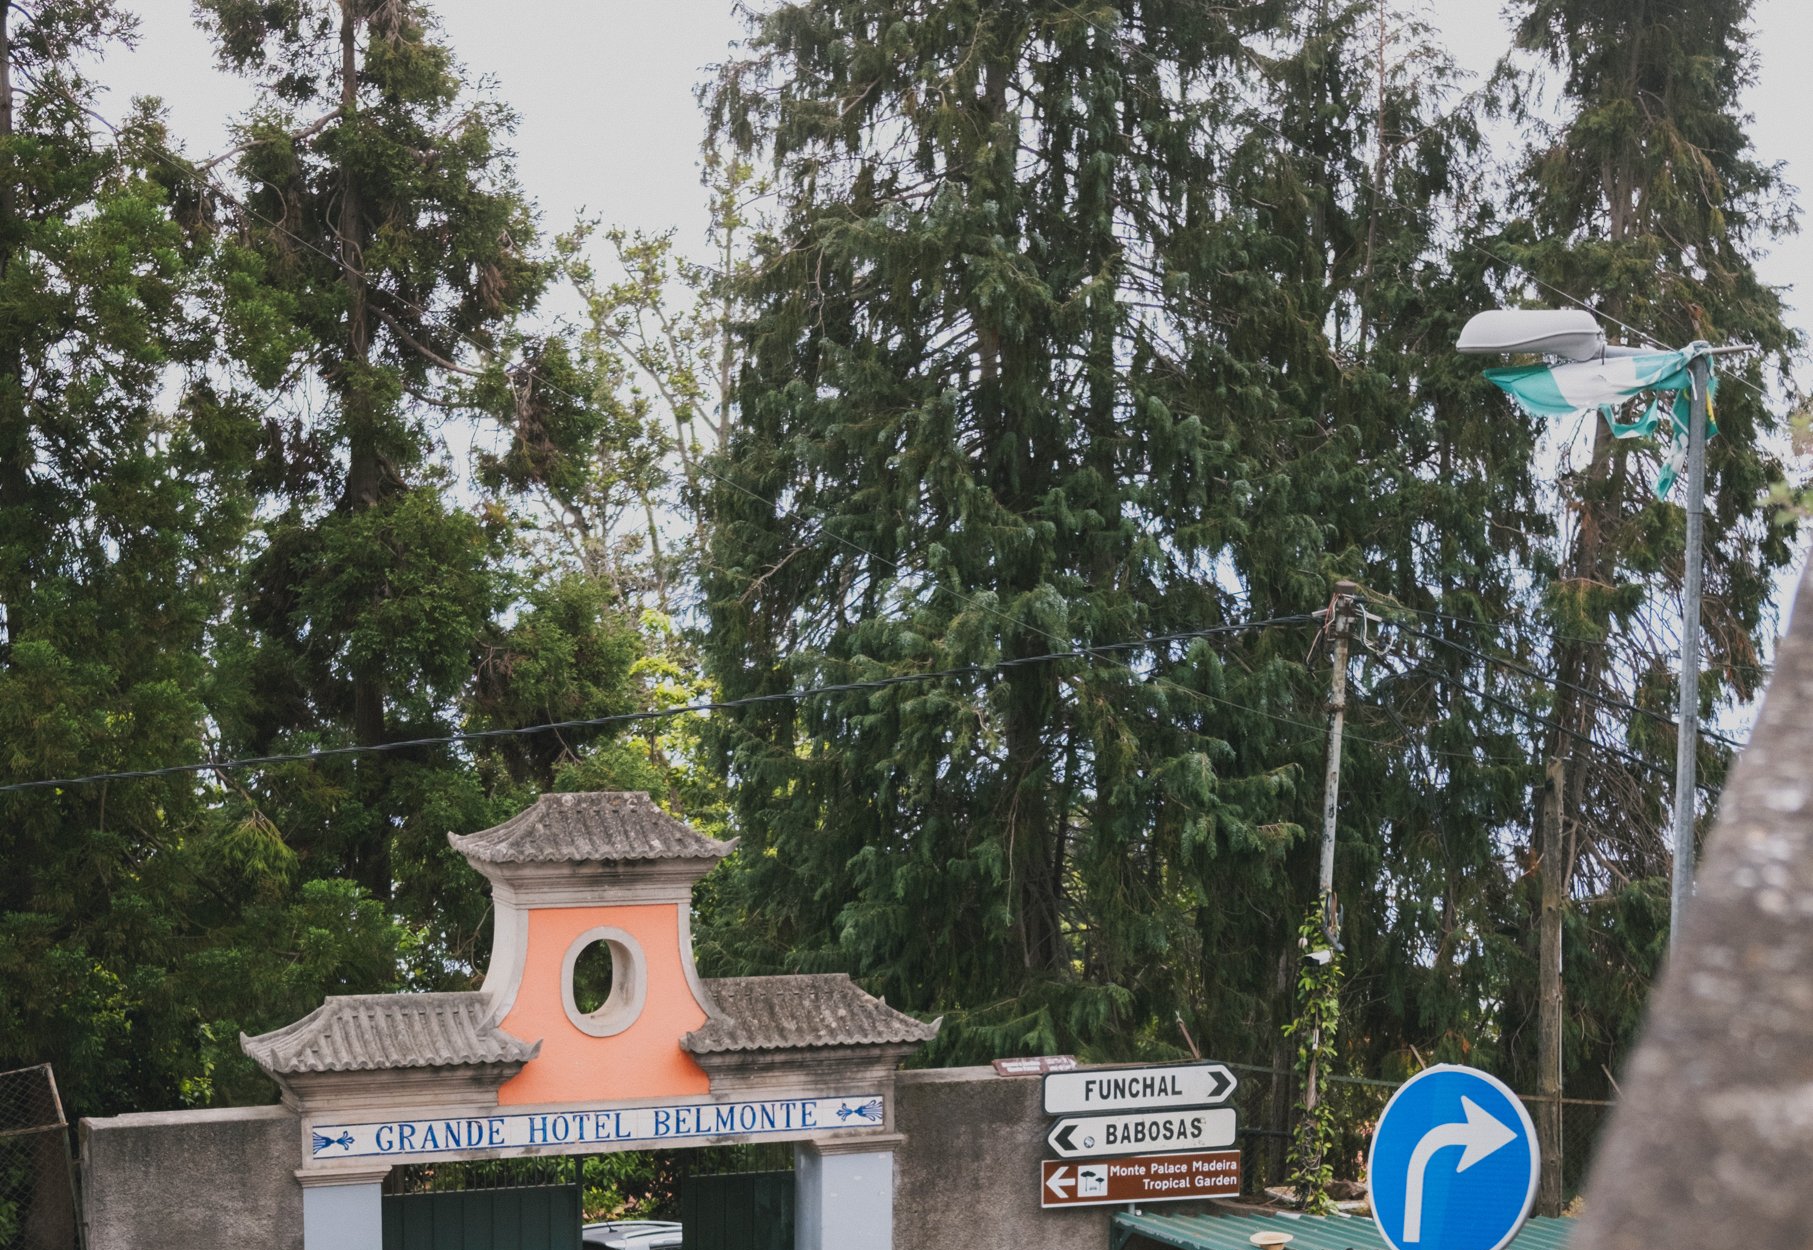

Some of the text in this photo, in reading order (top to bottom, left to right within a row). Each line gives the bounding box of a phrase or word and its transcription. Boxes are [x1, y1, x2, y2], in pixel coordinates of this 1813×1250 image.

[1085, 1075, 1182, 1101] FUNCHAL
[375, 1101, 817, 1152] GRANDE HOTEL BELMONTE
[1105, 1117, 1203, 1145] BABOSAS
[1109, 1161, 1237, 1177] Monte Palace Madeira
[1142, 1174, 1238, 1191] Tropical Garden
